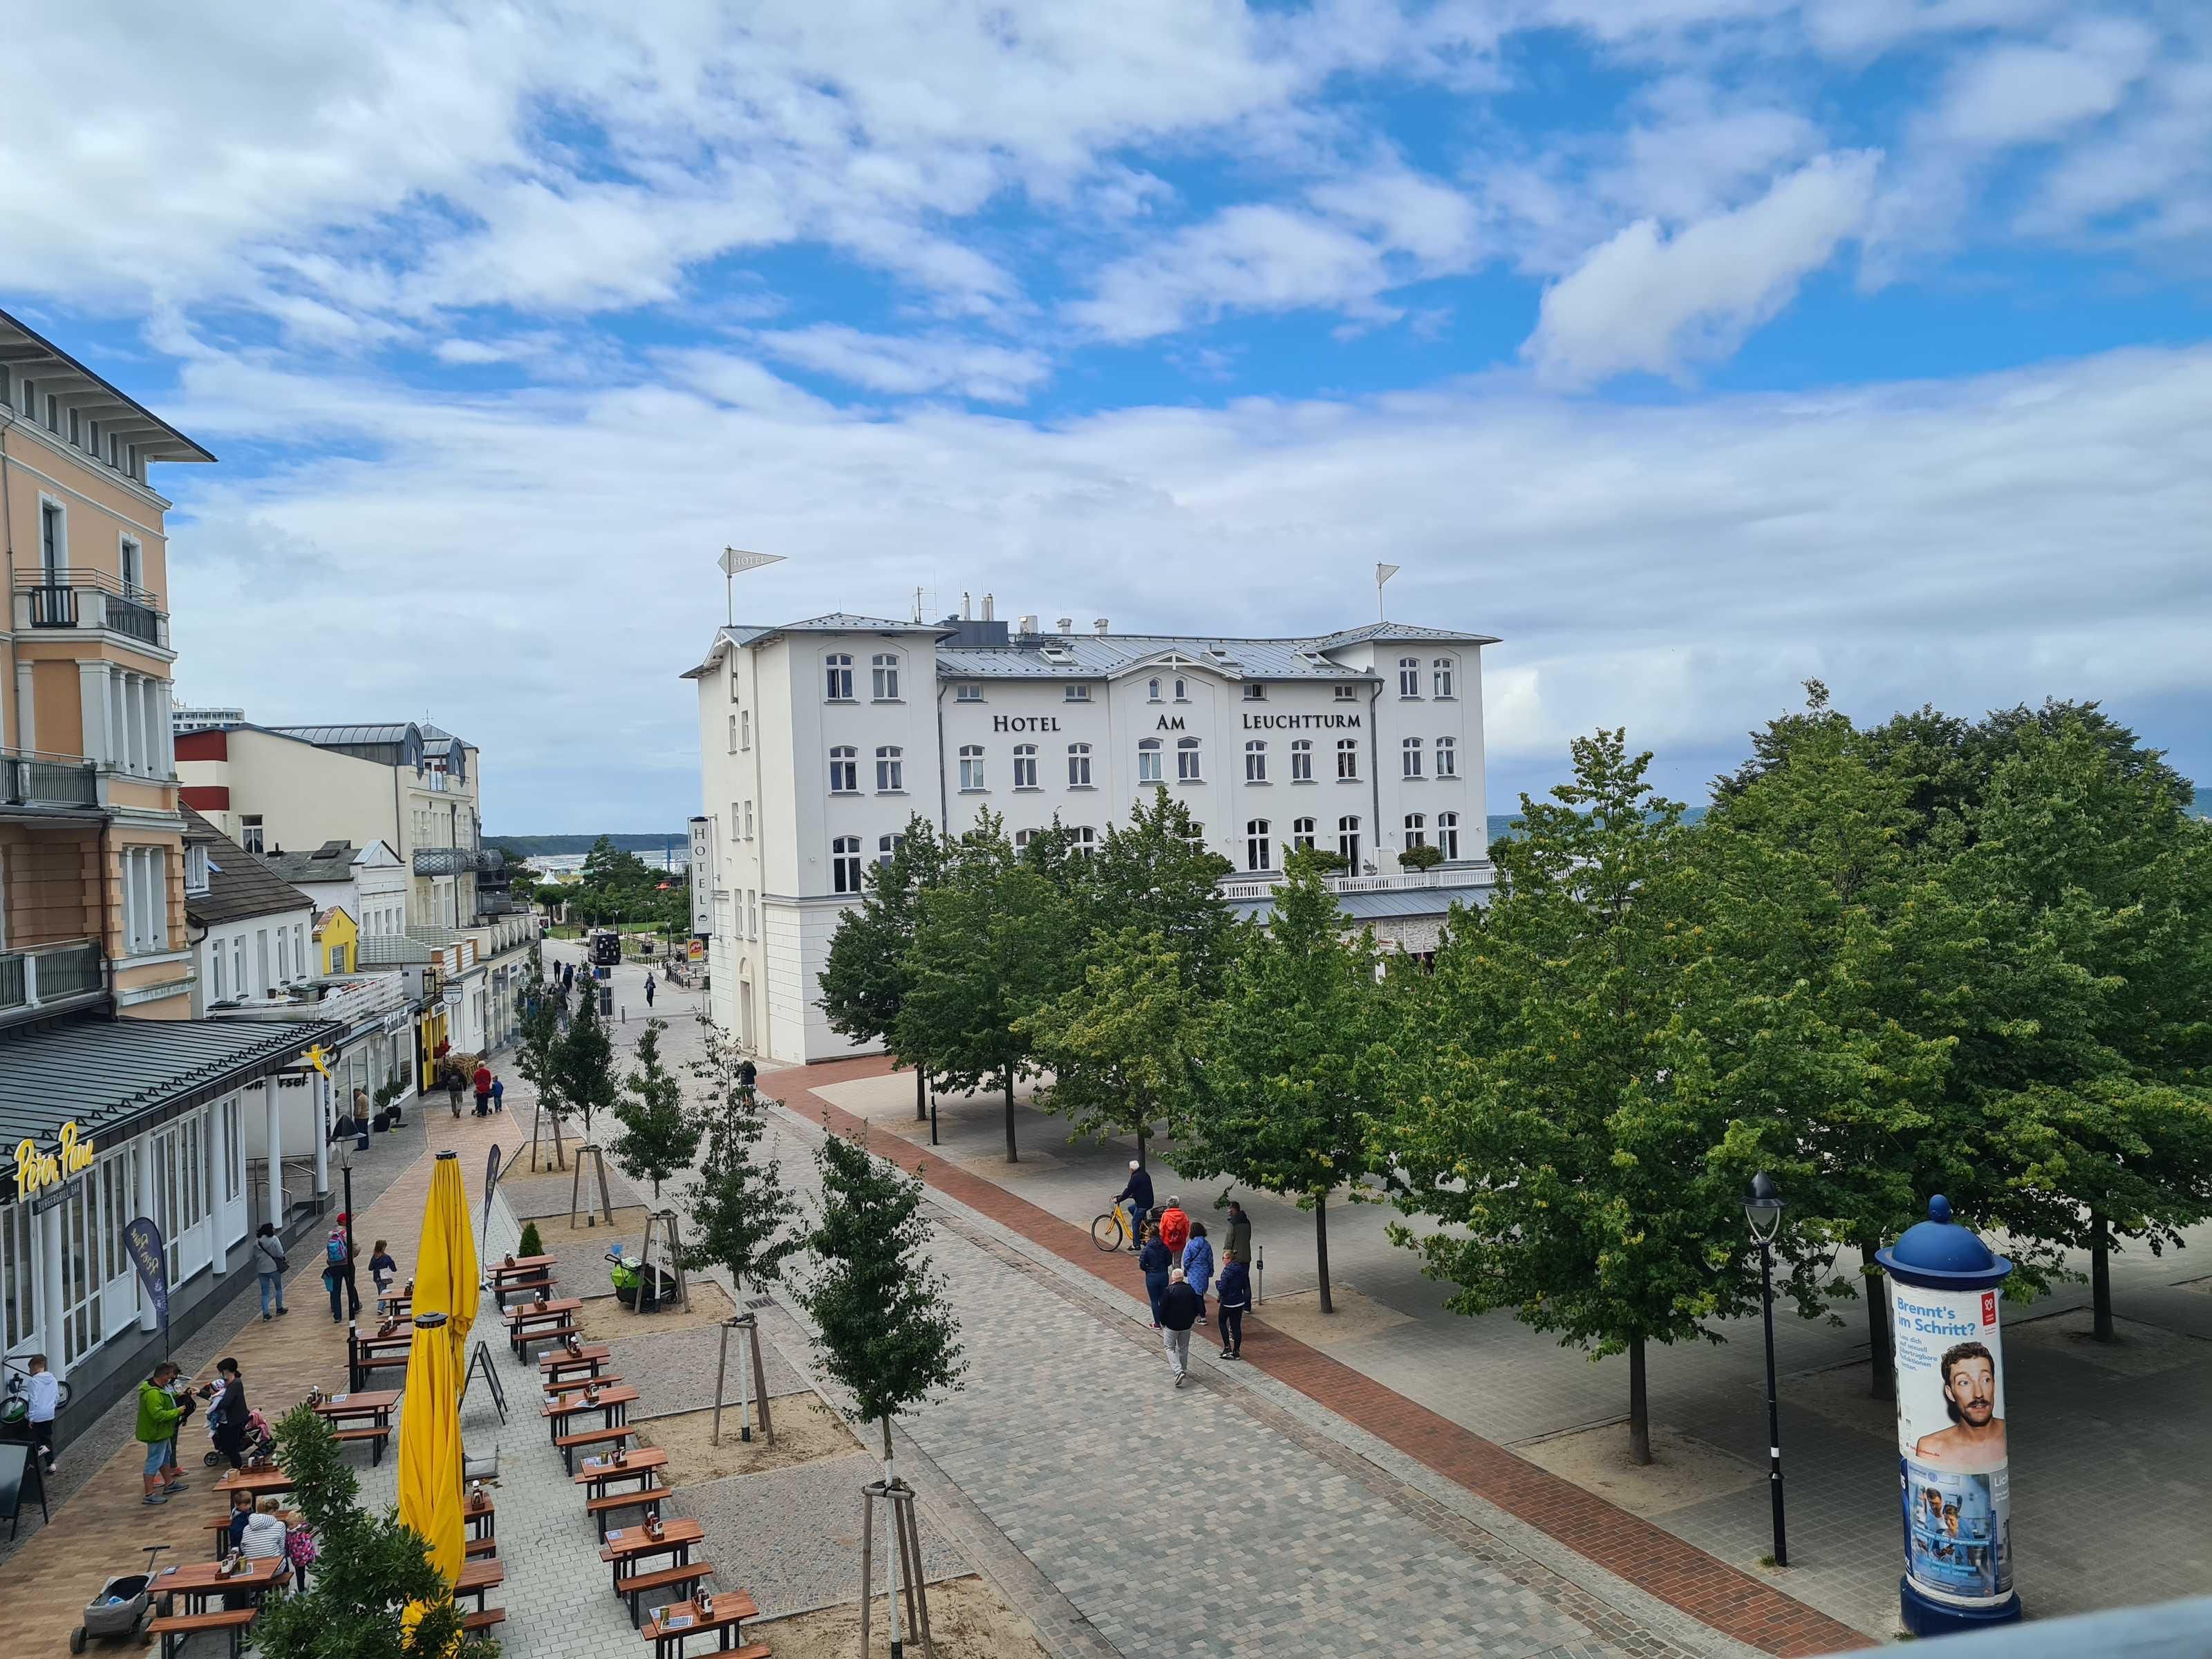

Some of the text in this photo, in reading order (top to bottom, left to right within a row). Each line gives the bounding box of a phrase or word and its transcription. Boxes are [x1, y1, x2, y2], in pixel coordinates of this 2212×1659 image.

[733, 555, 764, 565] HOTEL
[993, 713, 1362, 732] HOTEL AM LEUCHTTURM
[694, 828, 706, 905] HOTEL
[12, 1121, 95, 1203] Peter Pane
[1897, 1297, 1956, 1320] Brennt's
[1898, 1312, 1911, 1329] im
[1915, 1318, 1976, 1336] Schritt?
